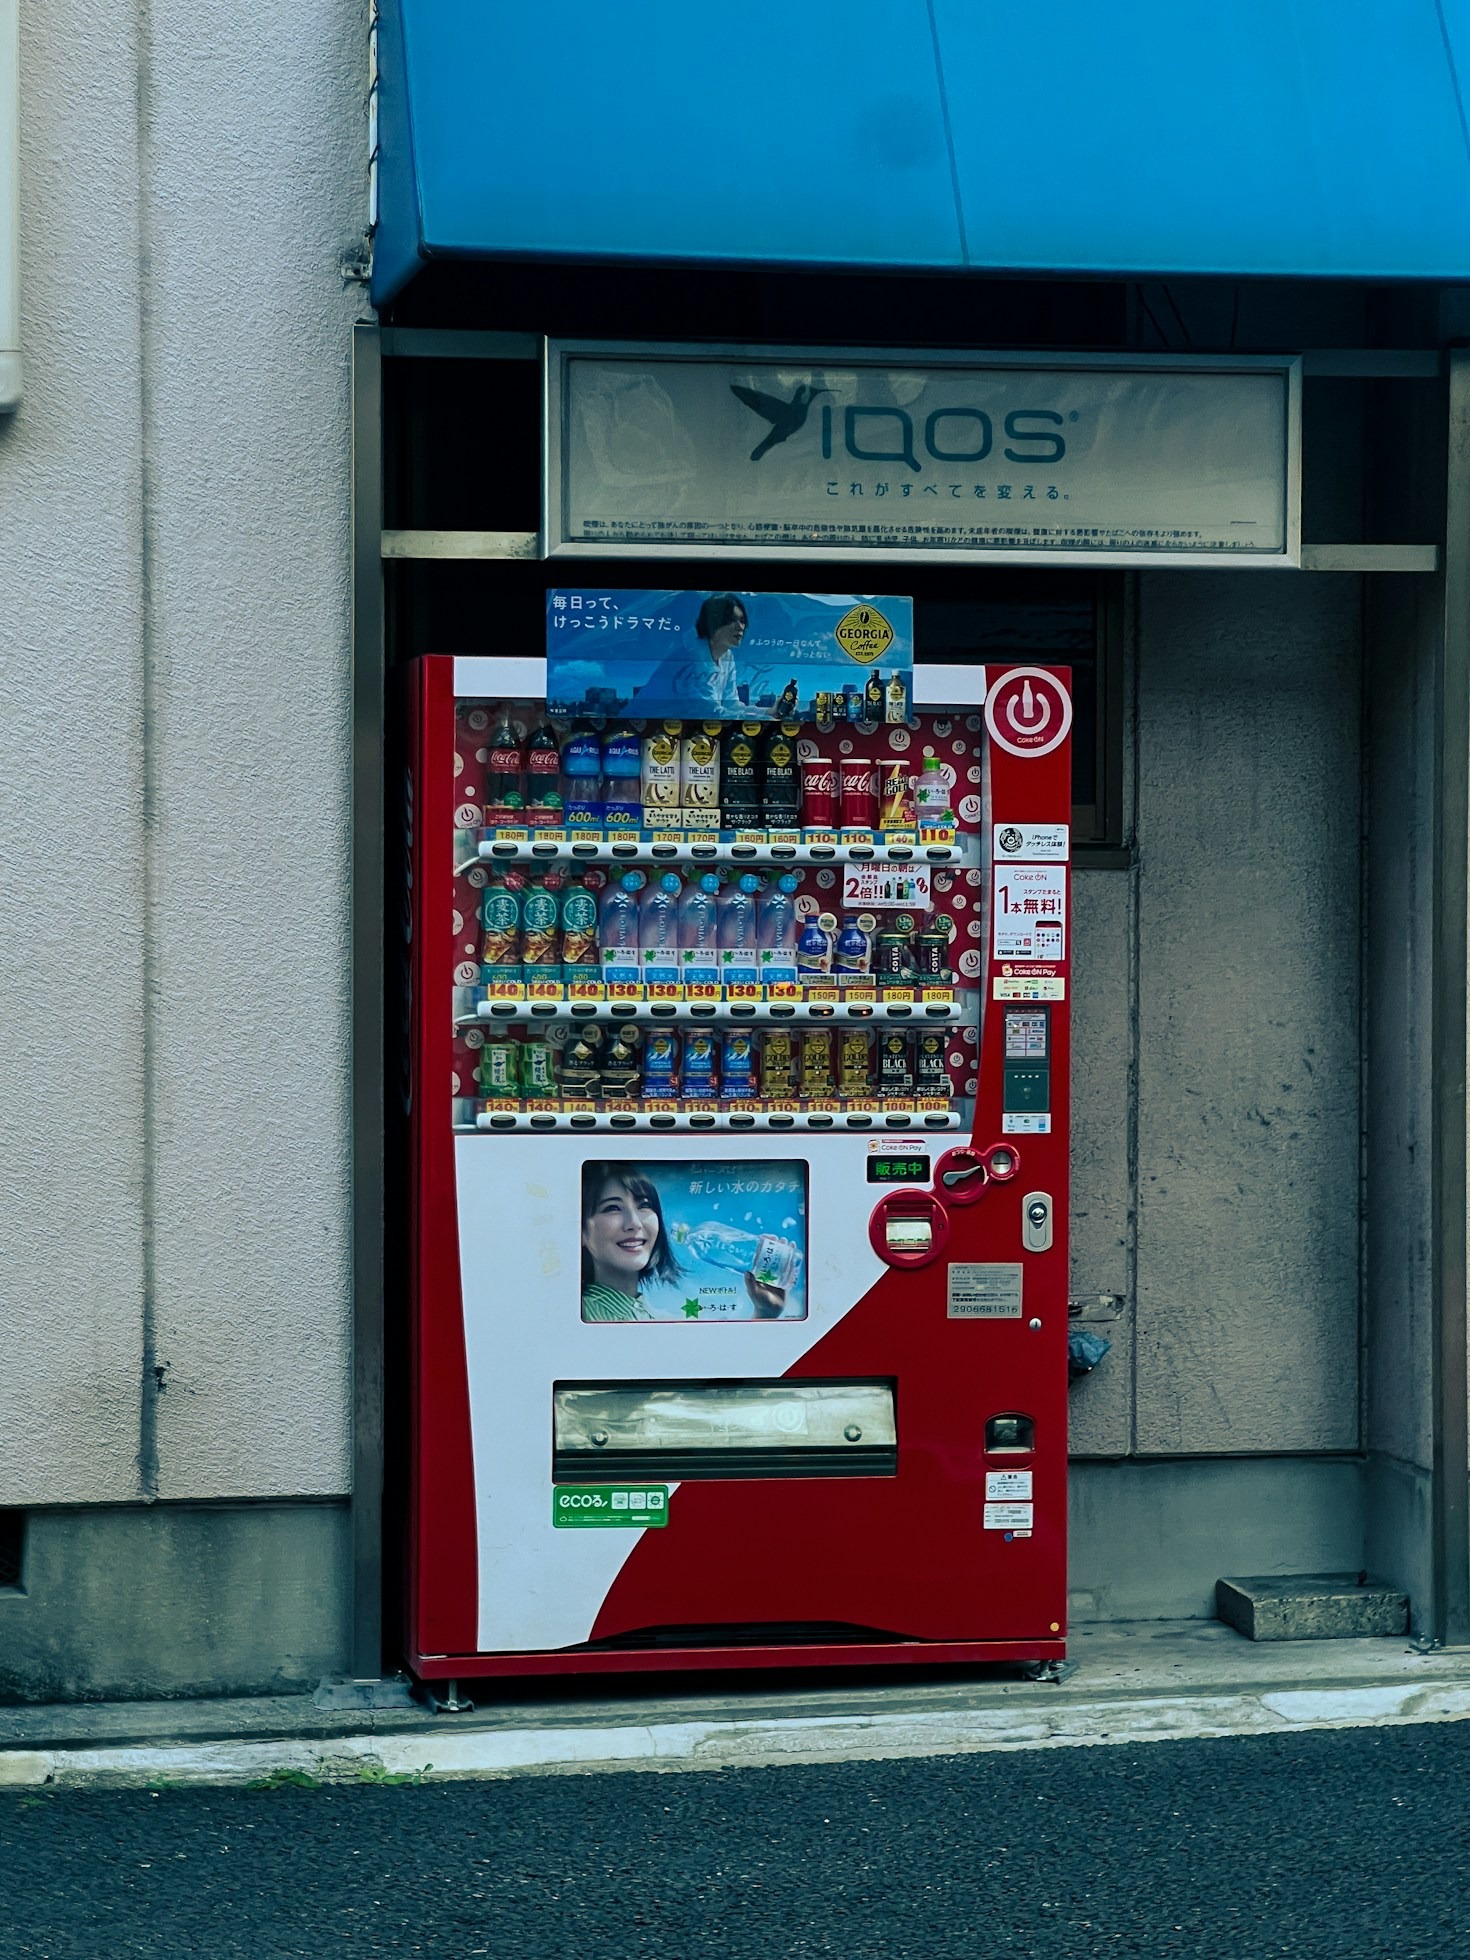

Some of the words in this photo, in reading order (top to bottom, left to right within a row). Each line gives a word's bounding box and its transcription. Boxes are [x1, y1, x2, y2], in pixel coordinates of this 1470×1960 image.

[822, 405, 1066, 472] IQOS
[826, 482, 1070, 500] これがすべてを変える。
[553, 596, 619, 610] 毎日って、
[554, 616, 680, 631] けっこうドラマだ。
[840, 628, 889, 640] GEORGIA
[850, 640, 879, 651] Coffee
[501, 832, 524, 840] 180円
[539, 832, 563, 840] 180円
[575, 833, 600, 841] 180円
[613, 833, 636, 841] 180円
[1035, 872, 1047, 881] ON
[999, 886, 1061, 914] 1本無料!
[496, 899, 509, 925] 麦茶
[534, 899, 548, 925] 麦茶
[574, 899, 588, 925] 麦茶
[1043, 969, 1056, 977] Pay
[812, 991, 835, 1000] 150円
[849, 991, 873, 1000] 150円
[887, 991, 910, 1000] 180円
[927, 991, 950, 1000] 180円
[882, 1059, 906, 1068] BLACK
[920, 1059, 944, 1068] BLACK
[885, 1102, 912, 1110] 100円
[920, 1102, 946, 1110] 100円
[876, 1162, 922, 1176] 販売中
[688, 1180, 800, 1195] 新しい水のカタチ
